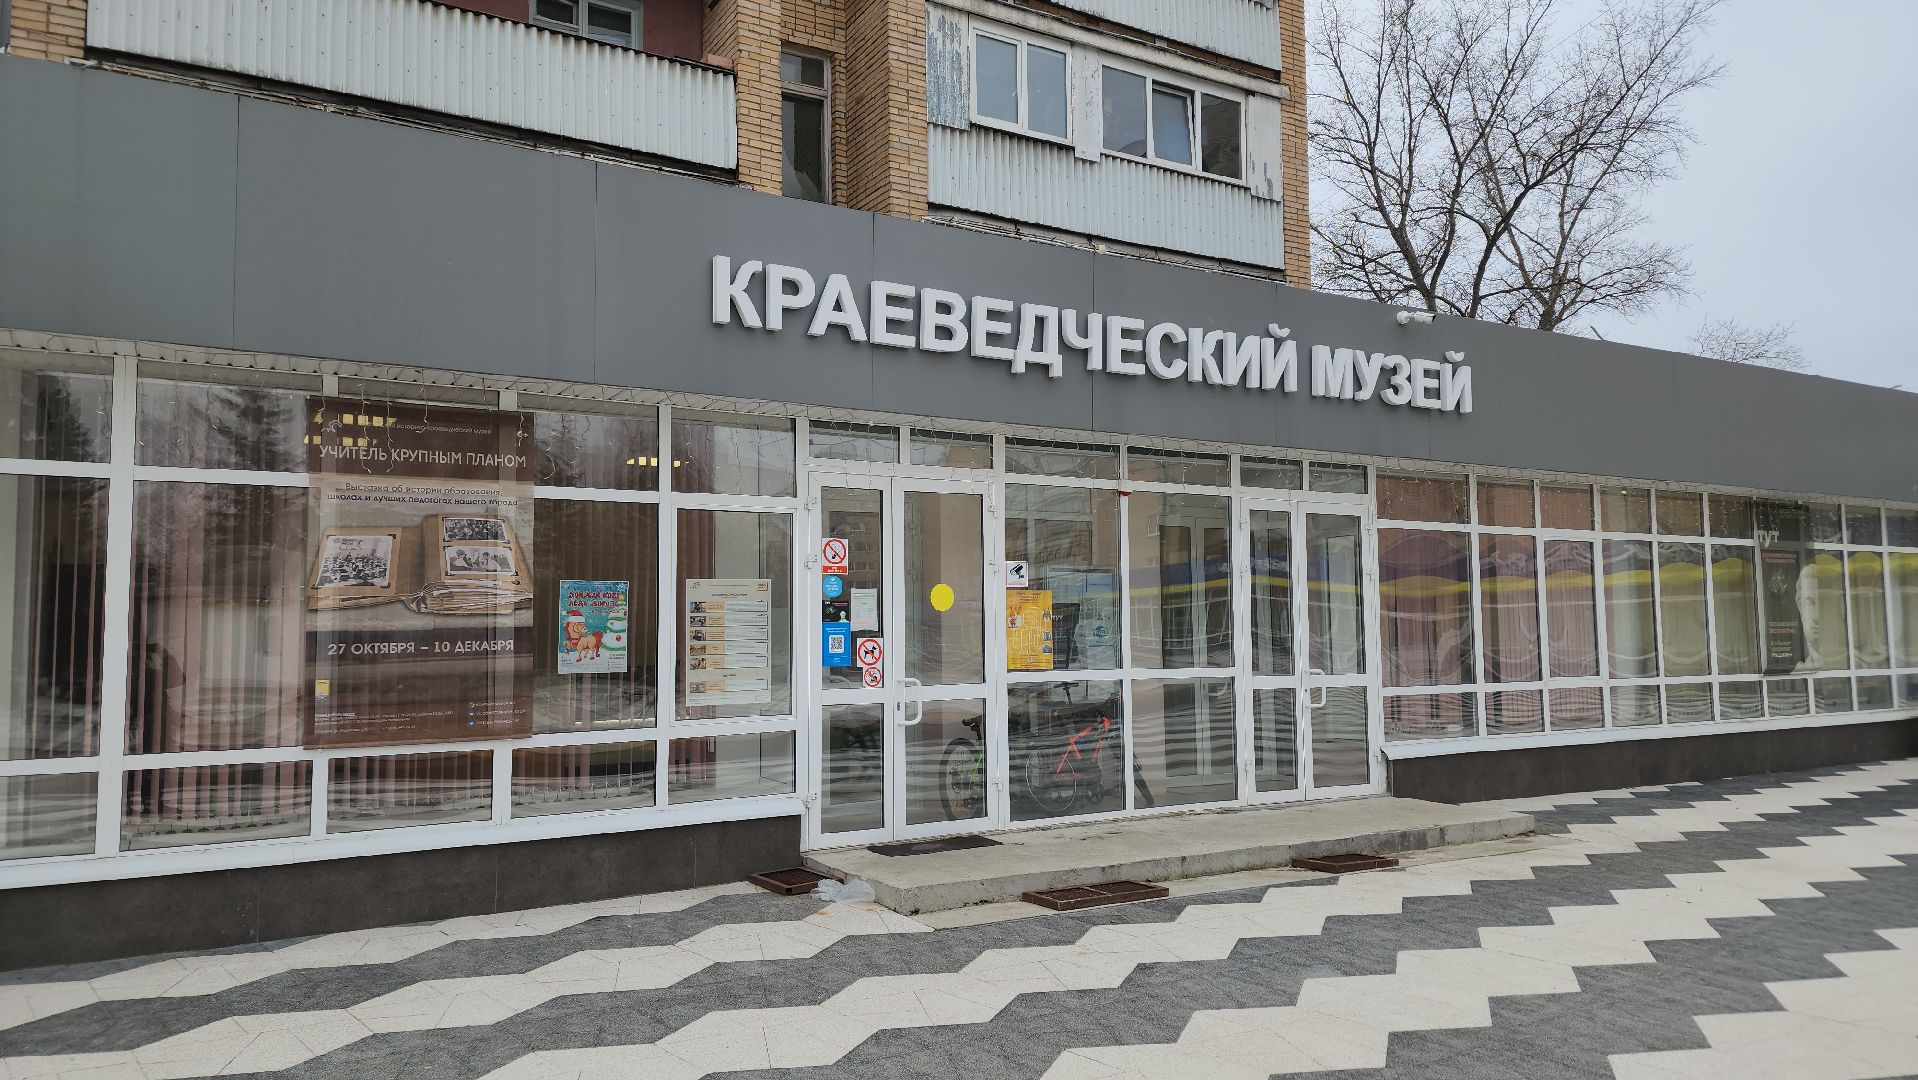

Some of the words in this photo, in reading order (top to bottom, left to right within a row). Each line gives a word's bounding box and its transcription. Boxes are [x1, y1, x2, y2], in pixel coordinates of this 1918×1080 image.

[712, 255, 1298, 393] КРАЕВЕДЧЕСКИЙ
[1311, 344, 1473, 414] МУЗЕЙ
[319, 445, 388, 461] УЧИТЕЛЬ
[391, 448, 463, 465] КРУПНЫМ
[466, 452, 526, 468] ПЛАНОМ
[391, 483, 403, 493] об
[405, 486, 442, 496] истории
[327, 494, 363, 502] школах
[373, 495, 407, 504] лучших
[454, 498, 487, 506] нашего
[327, 643, 346, 655] 27
[351, 641, 415, 655] ОКТЯБРЯ
[434, 641, 450, 653] 10
[454, 639, 514, 654] ДЕКАБРЯ
